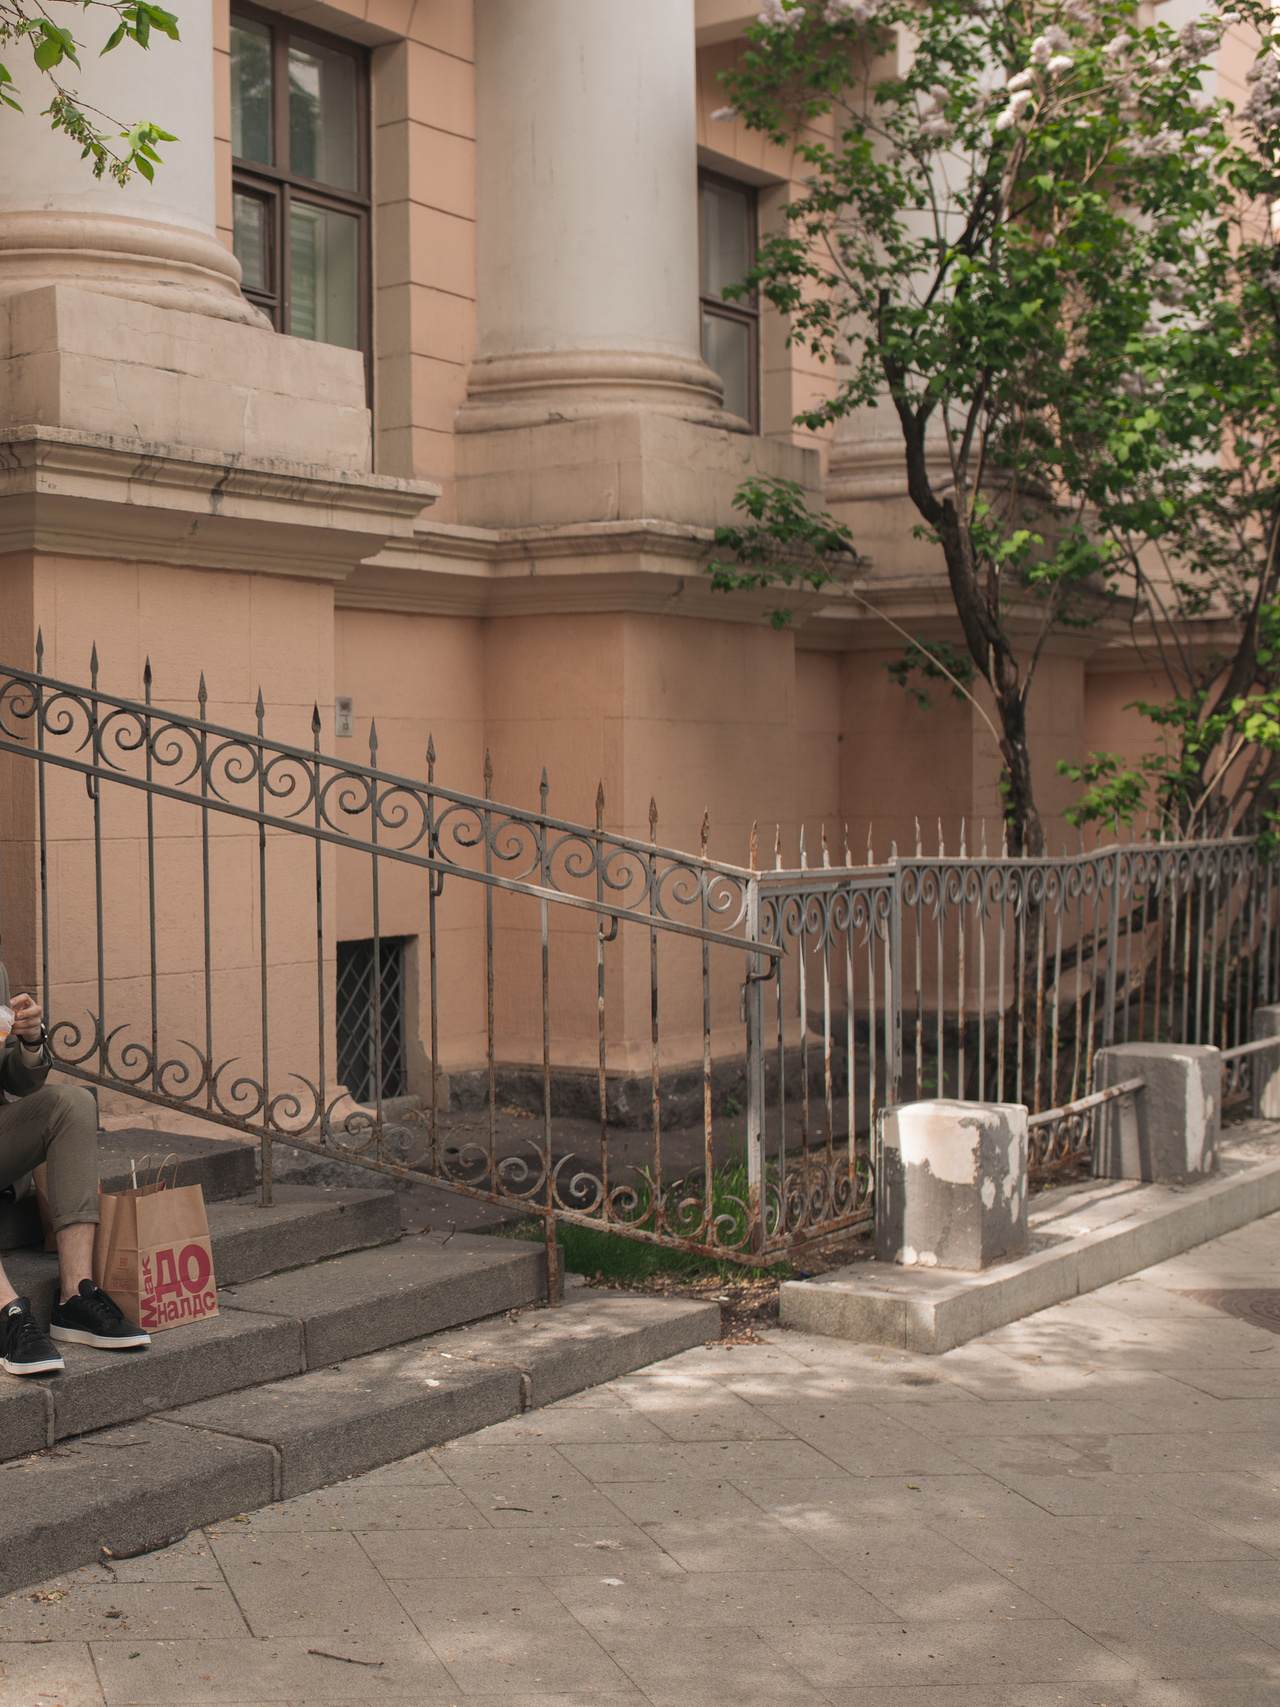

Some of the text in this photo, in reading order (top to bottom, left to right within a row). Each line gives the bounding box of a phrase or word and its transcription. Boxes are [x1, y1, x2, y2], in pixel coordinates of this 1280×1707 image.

[141, 1255, 158, 1328] Мак
[154, 1244, 211, 1303] ДО
[157, 1292, 216, 1324] налдс
